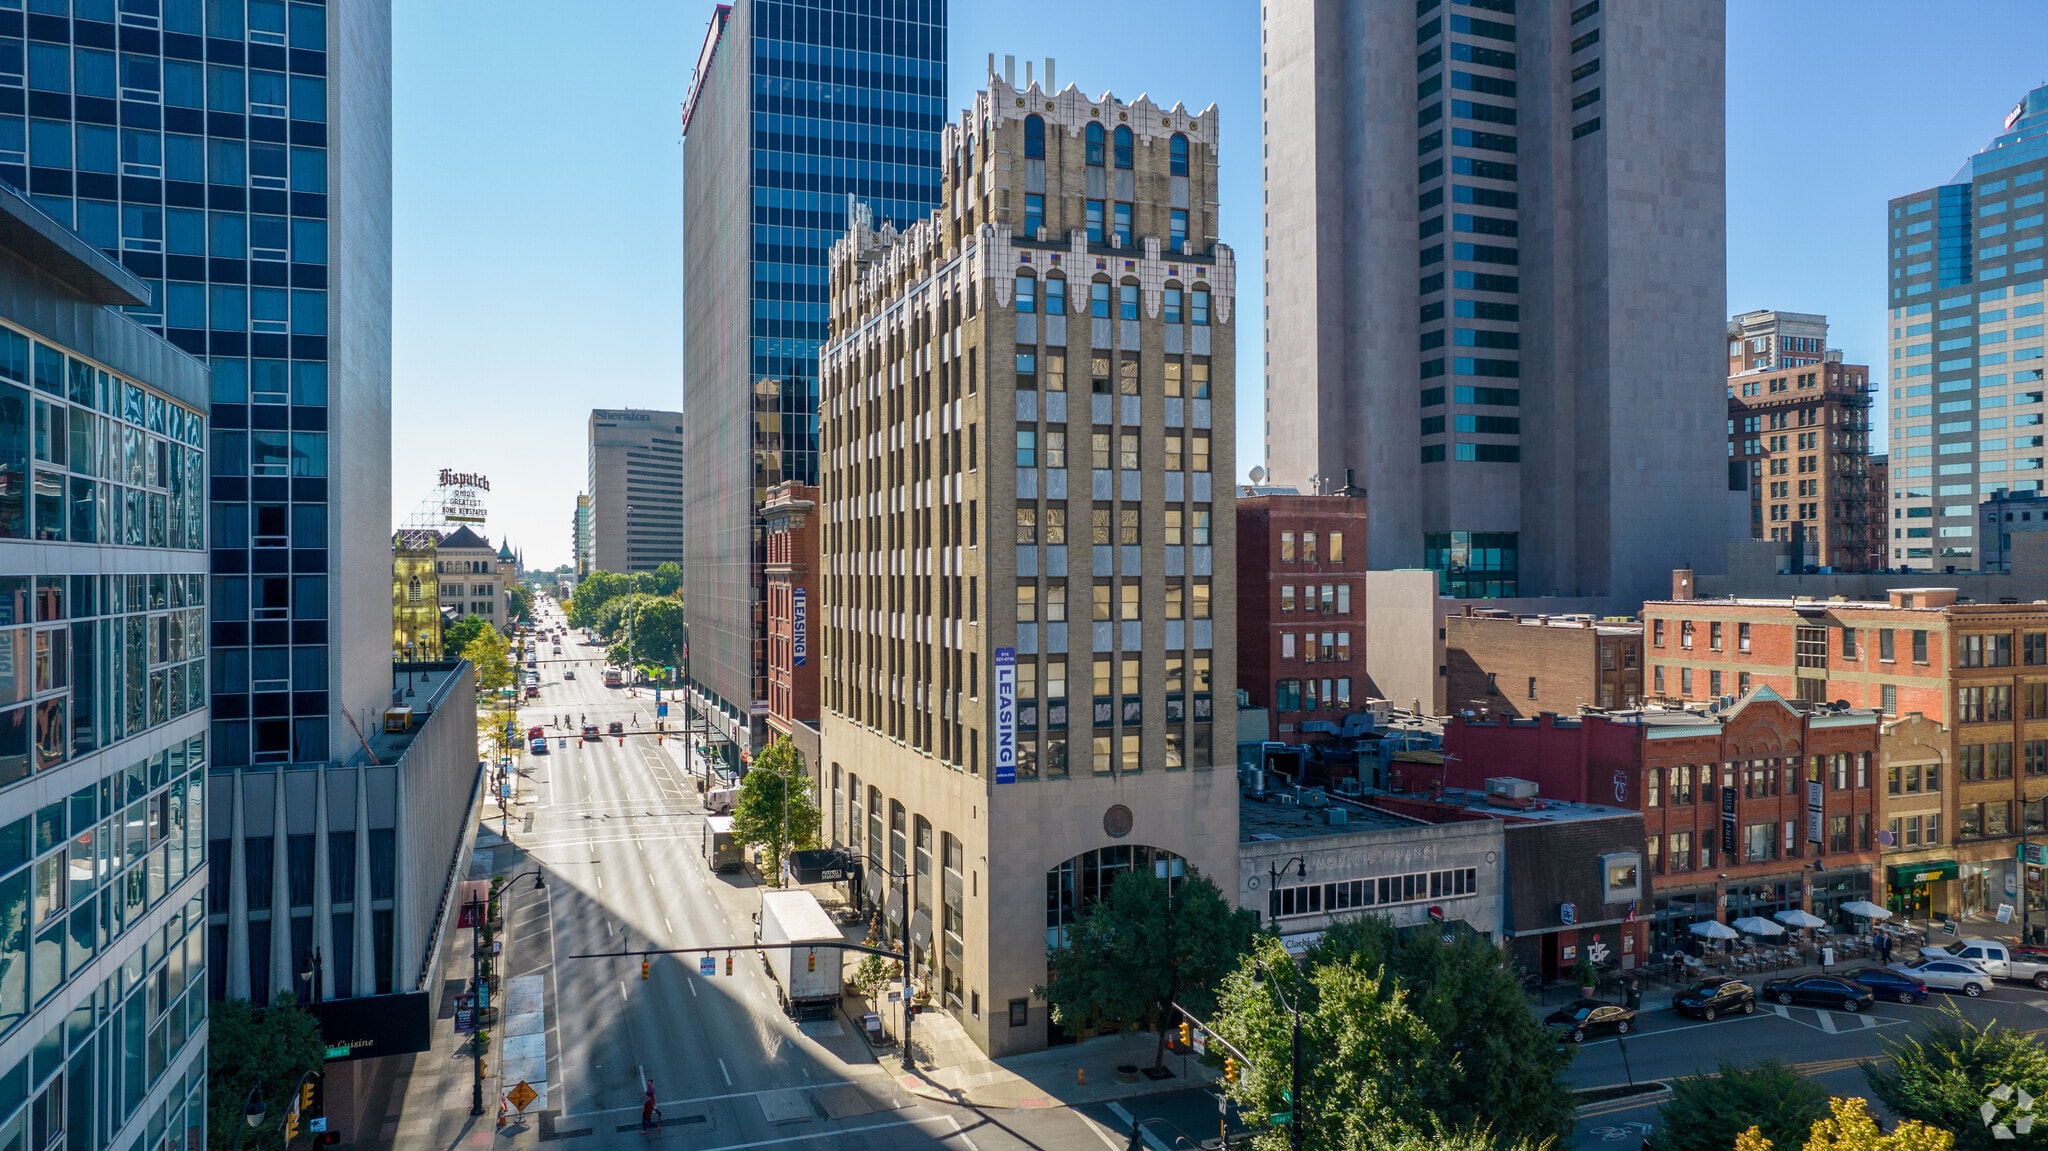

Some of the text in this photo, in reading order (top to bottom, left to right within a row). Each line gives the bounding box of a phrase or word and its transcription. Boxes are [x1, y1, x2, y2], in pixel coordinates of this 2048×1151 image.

[595, 410, 650, 421] Sheraton
[439, 468, 490, 492] Dispatch
[454, 489, 475, 497] OHIO'S
[450, 498, 481, 506] GREATEST
[459, 508, 487, 516] NEWSPAPER
[794, 599, 805, 653] LEASING
[1000, 669, 1012, 762] LEASING
[1312, 845, 1438, 869] MODERN FINANCE
[1914, 870, 1943, 882] SUBWAY
[338, 1039, 373, 1048] Cuisine
